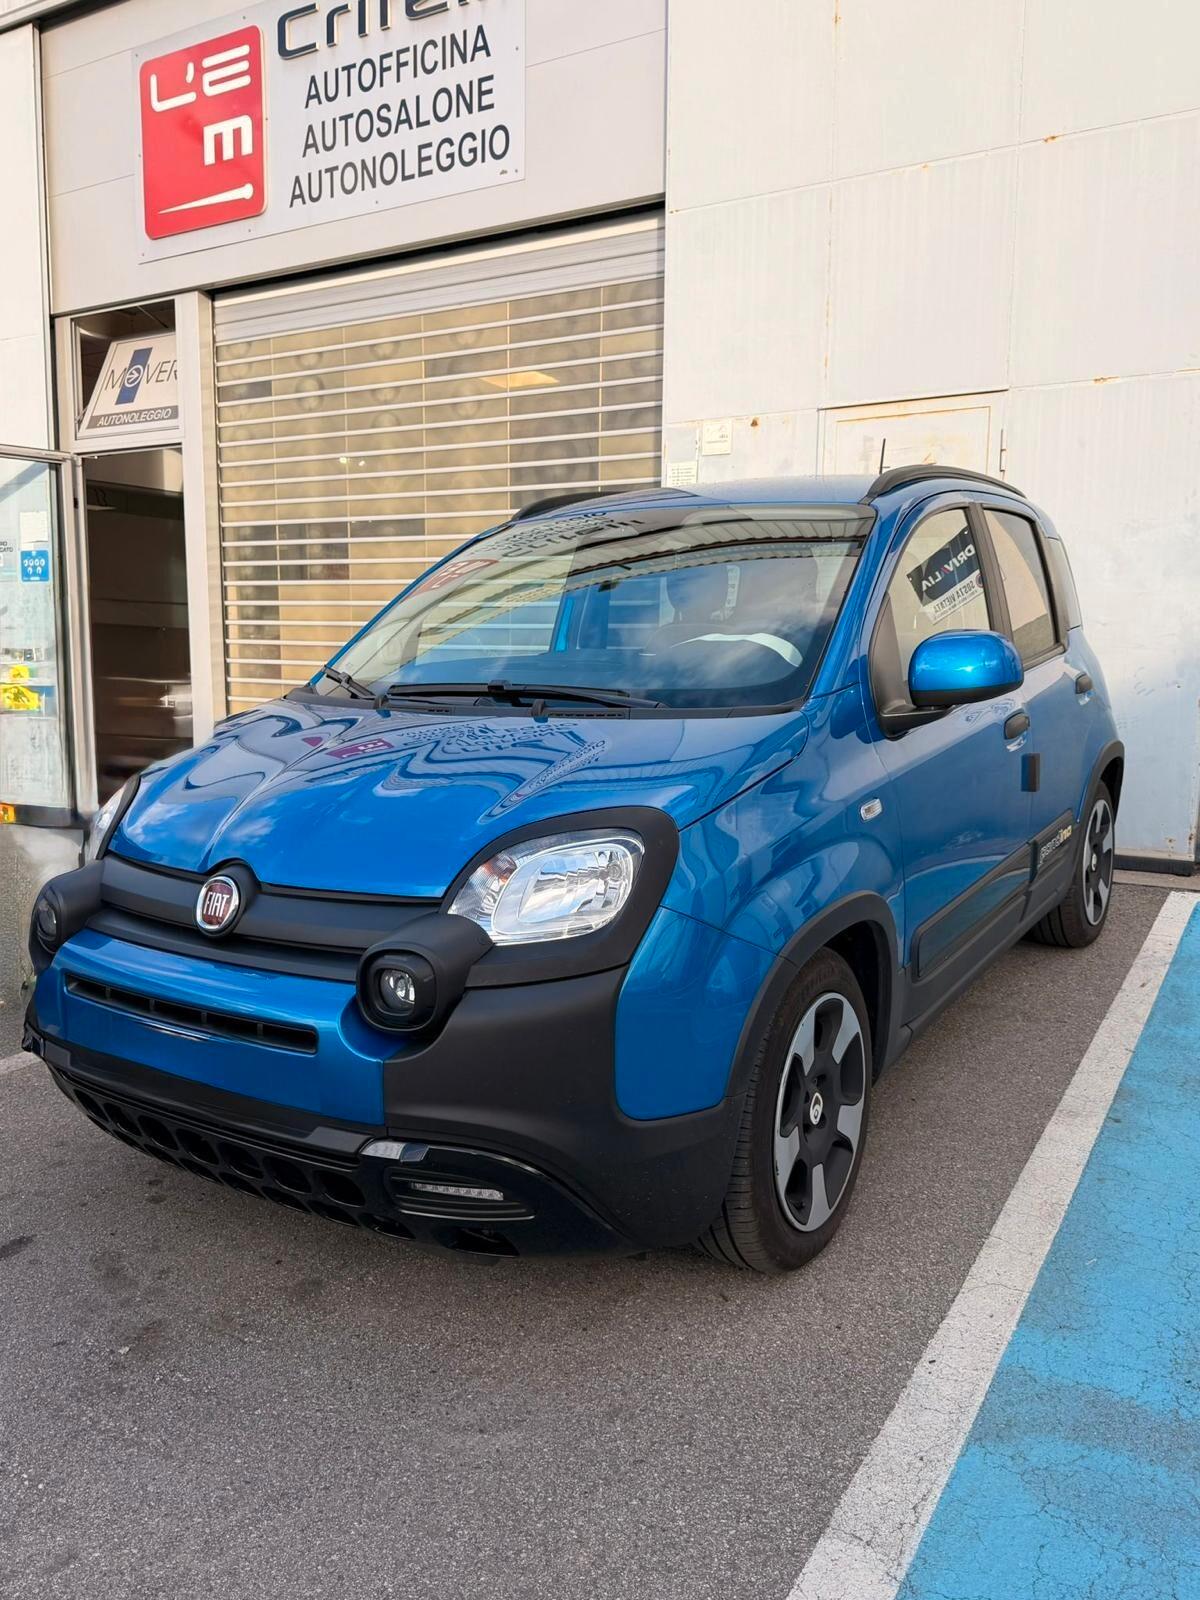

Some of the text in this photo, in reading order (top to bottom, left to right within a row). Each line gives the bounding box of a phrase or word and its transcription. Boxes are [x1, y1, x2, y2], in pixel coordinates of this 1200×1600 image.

[305, 24, 492, 109] AUTOFFICINA
[302, 74, 495, 158] AUTOSALONE
[289, 124, 510, 209] AUTONOLEGGIO
[97, 408, 171, 426] AUTONOLEGGIO
[203, 891, 231, 918] FIAT
